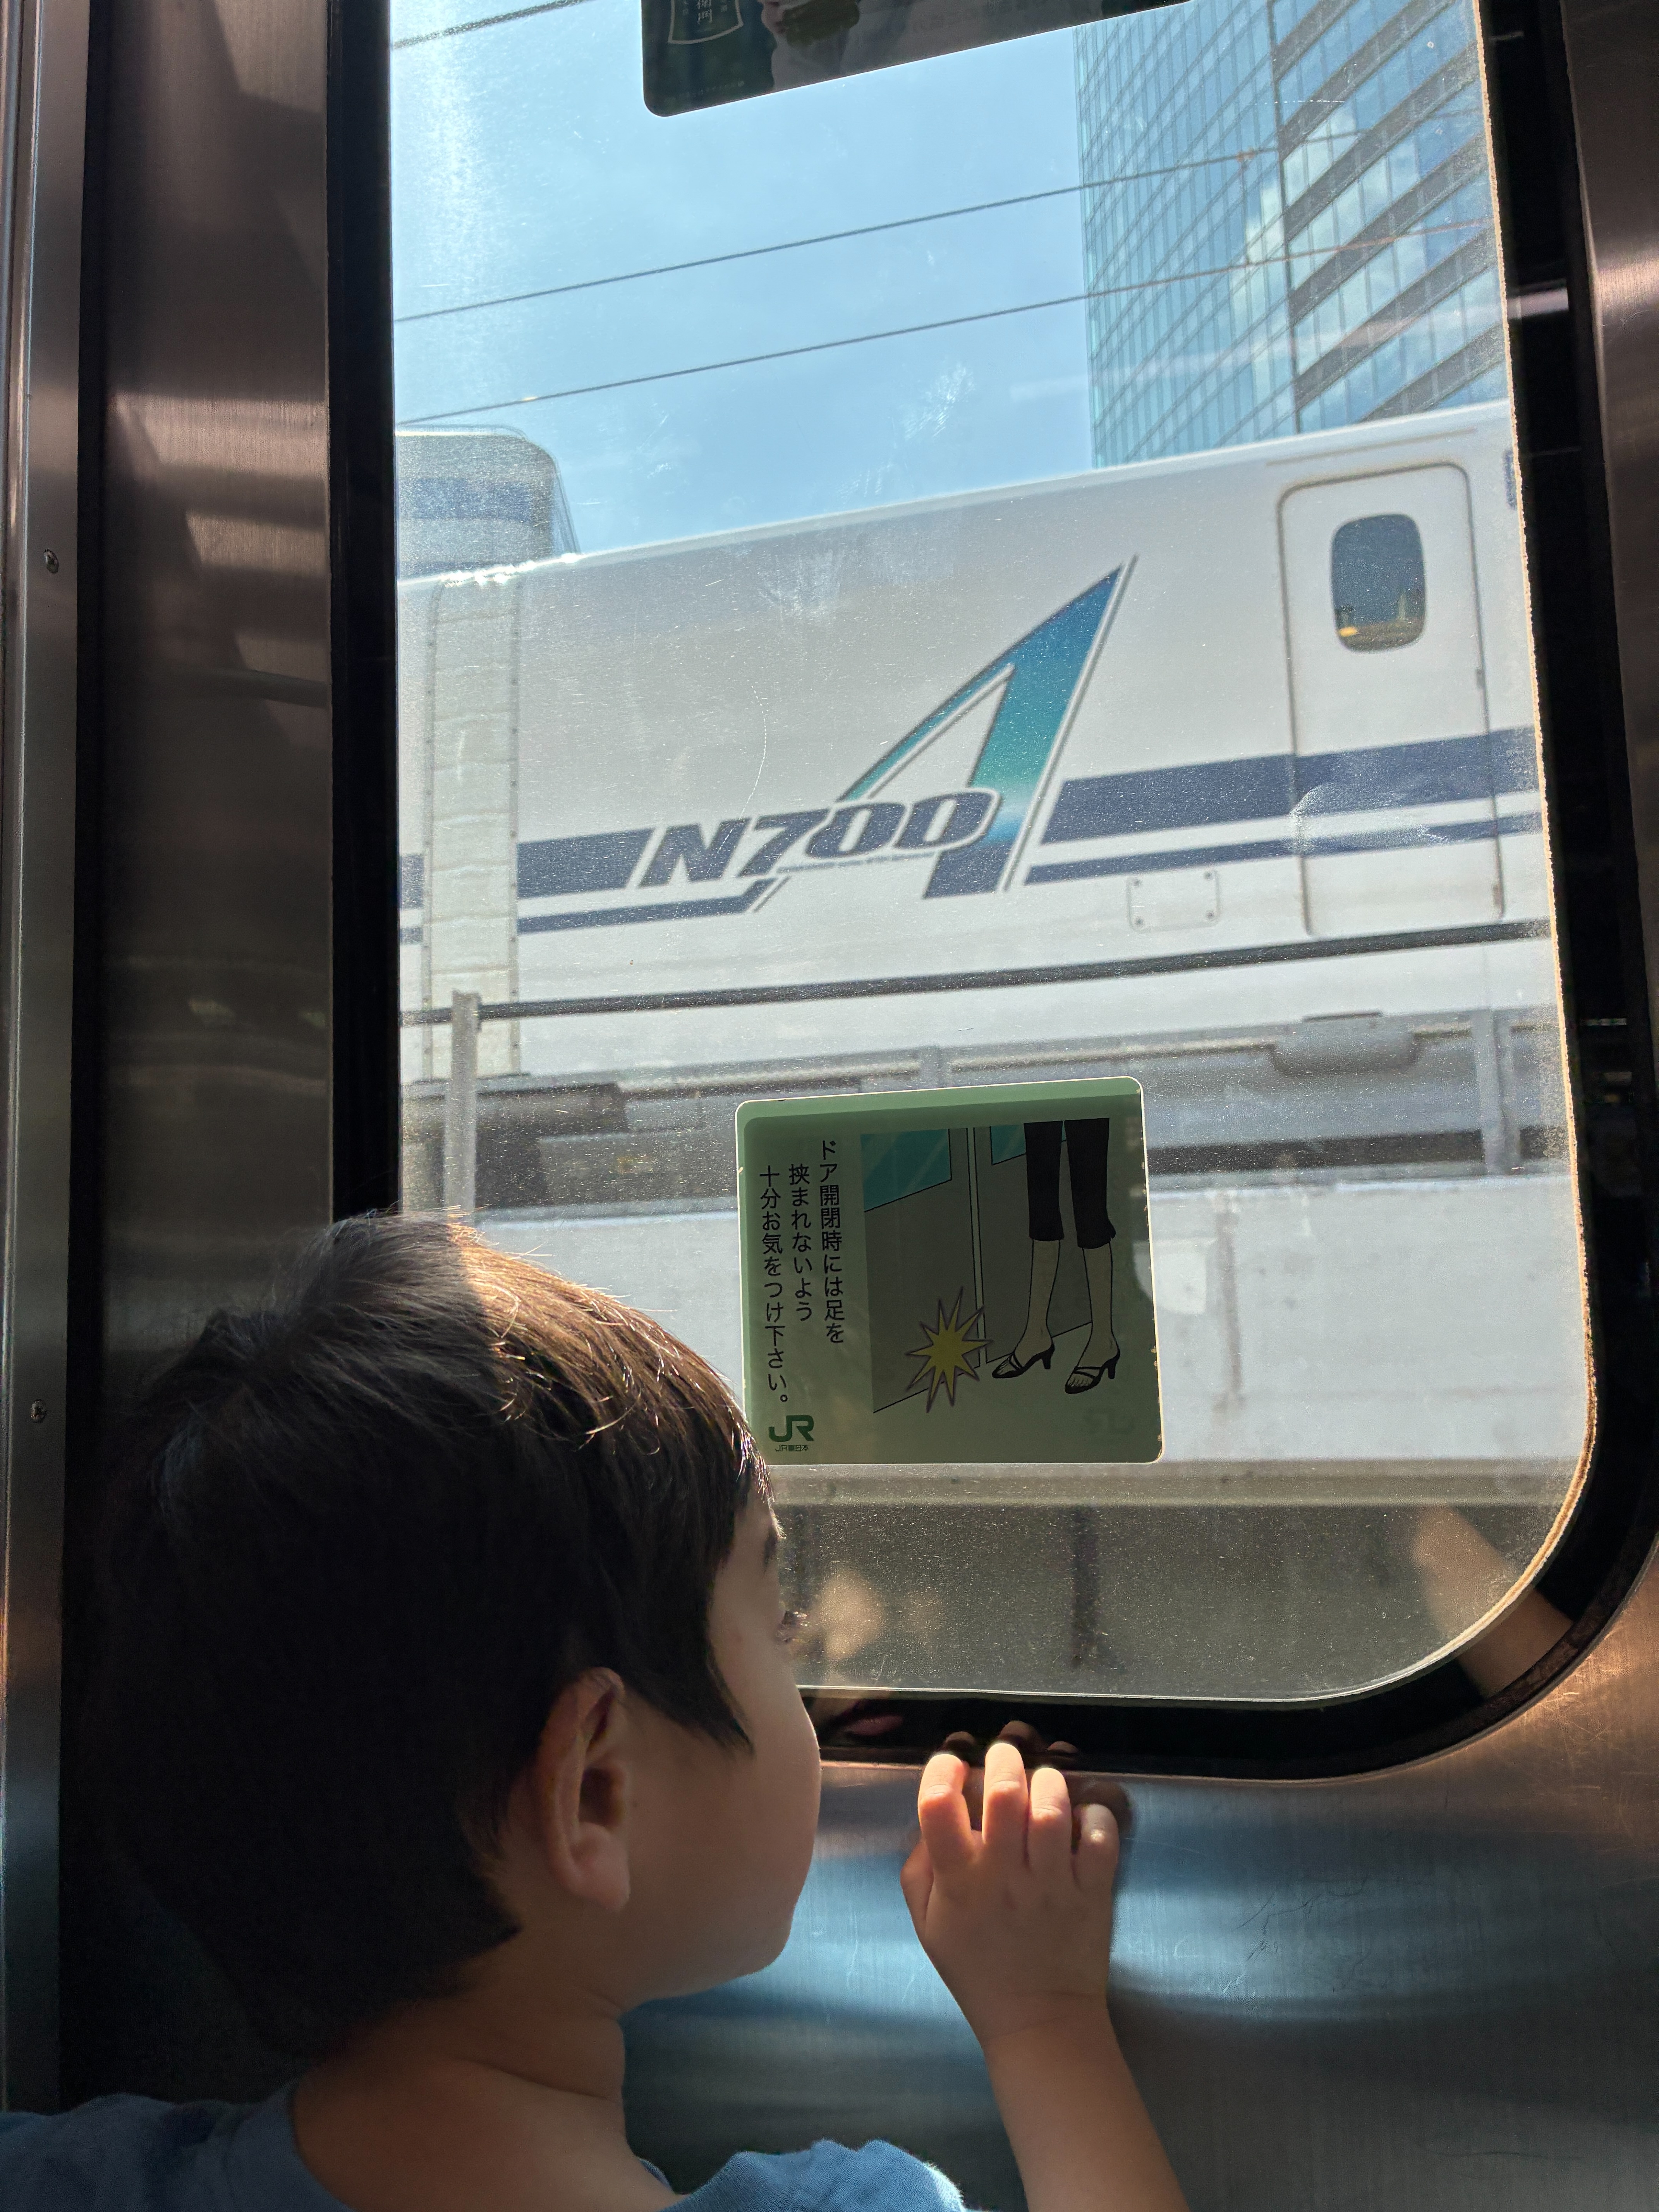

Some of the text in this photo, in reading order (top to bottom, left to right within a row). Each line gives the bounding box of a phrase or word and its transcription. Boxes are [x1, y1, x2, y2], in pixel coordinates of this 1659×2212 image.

[759, 1165, 788, 1402] 十分お気をつけ下さい。
[789, 1163, 812, 1321] 挟まれないよう
[820, 1140, 845, 1343] ドア開閉時には足を
[769, 1415, 814, 1442] JR
